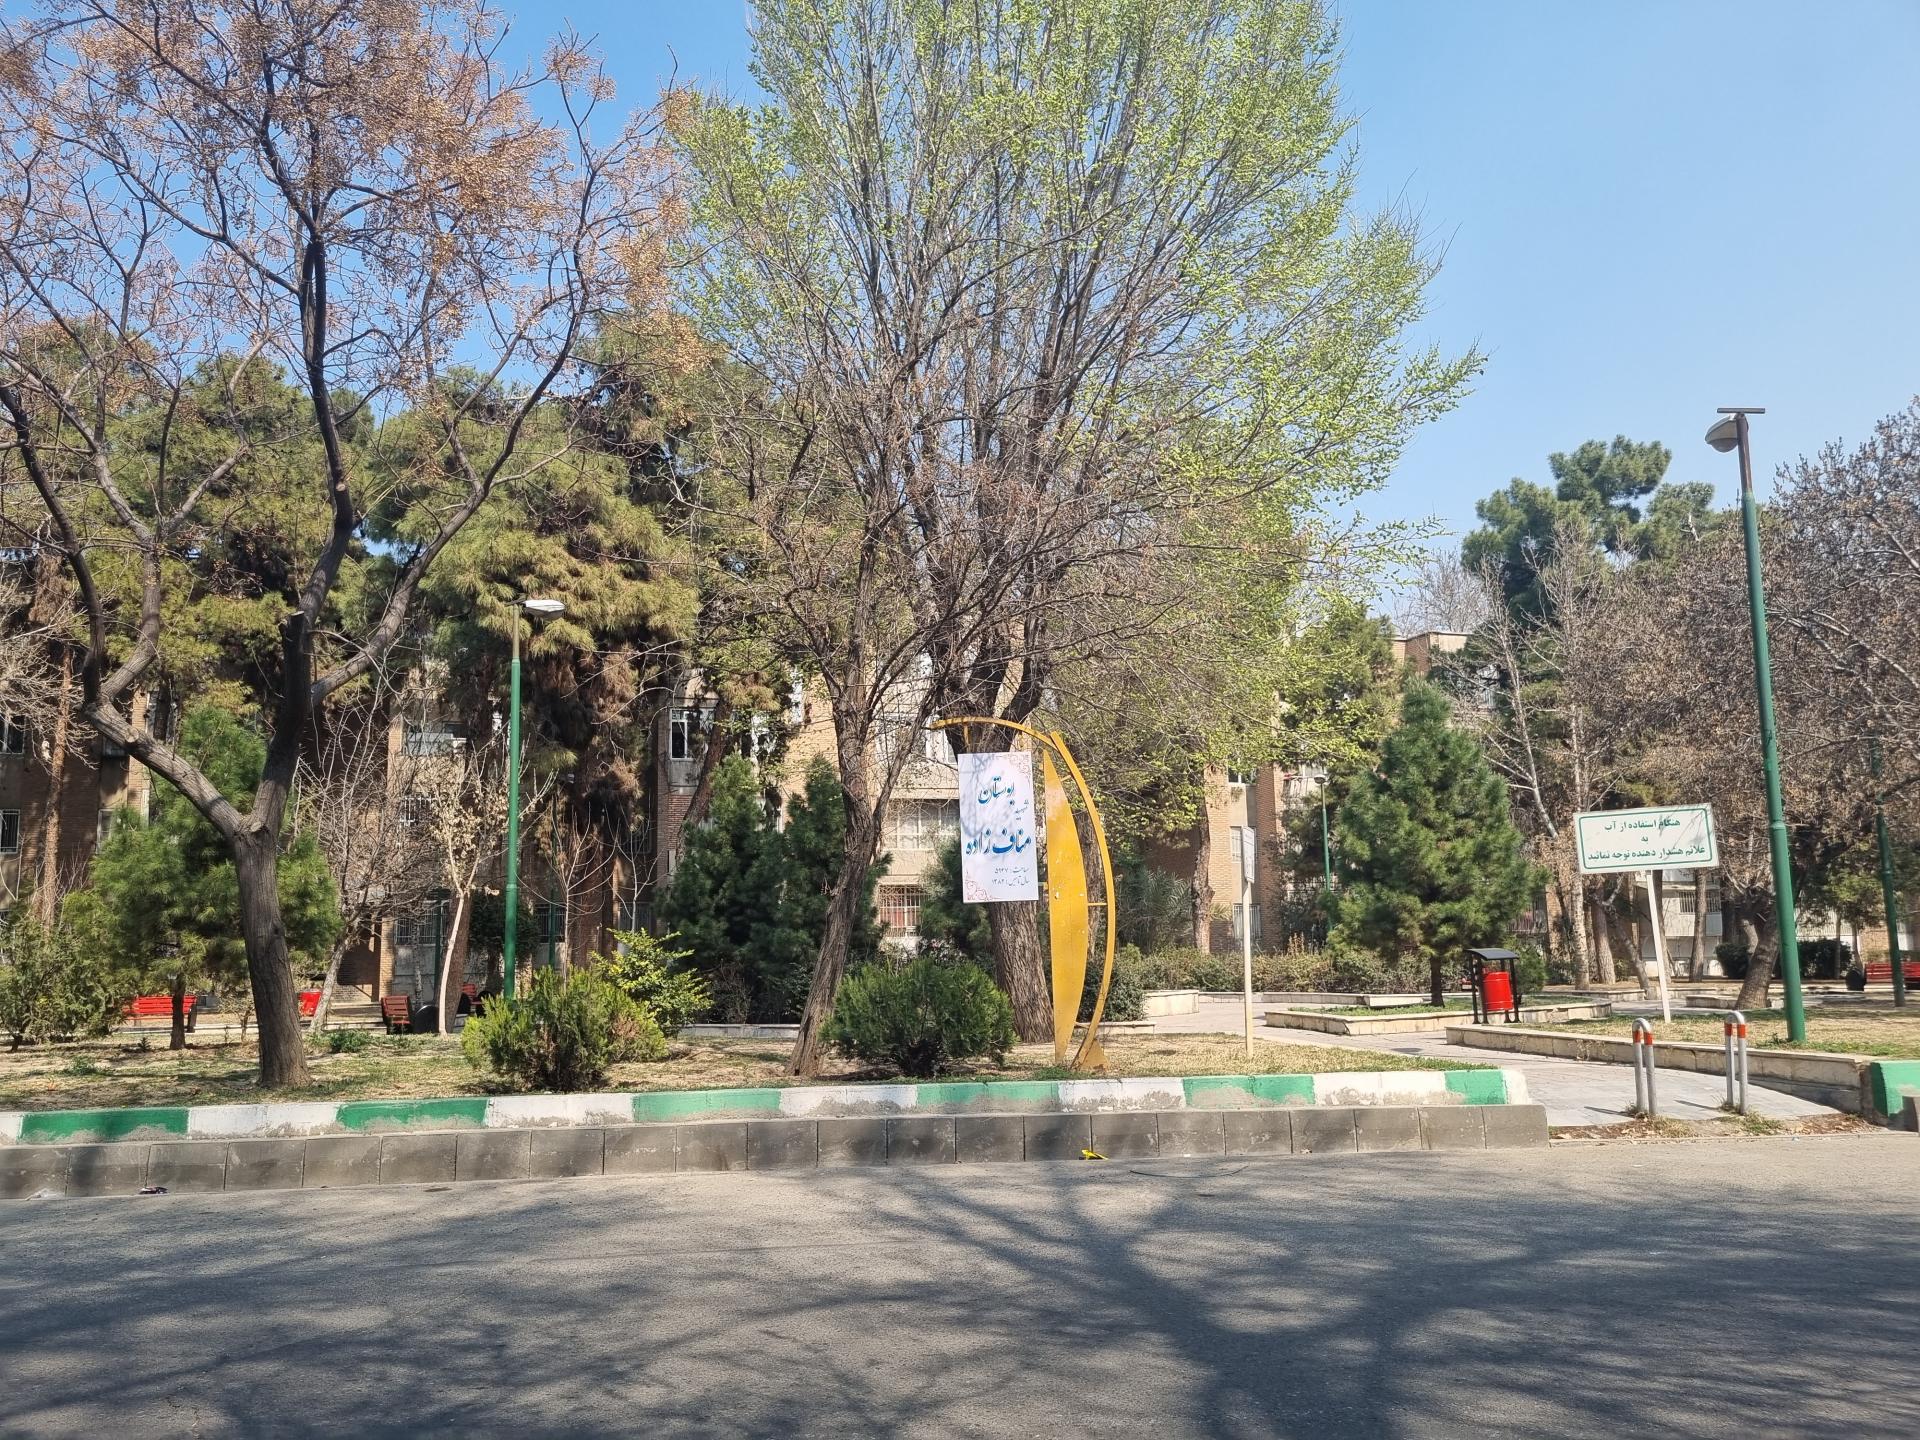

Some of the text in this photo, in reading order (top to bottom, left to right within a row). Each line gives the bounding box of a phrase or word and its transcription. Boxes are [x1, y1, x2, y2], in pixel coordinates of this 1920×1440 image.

[978, 776, 1015, 805] بوستان
[1604, 821, 1616, 831] آب
[1628, 820, 1657, 829] استفاده
[965, 827, 1031, 855] مناف زاده
[1611, 851, 1631, 861] توجه
[1631, 849, 1657, 858] دهنده
